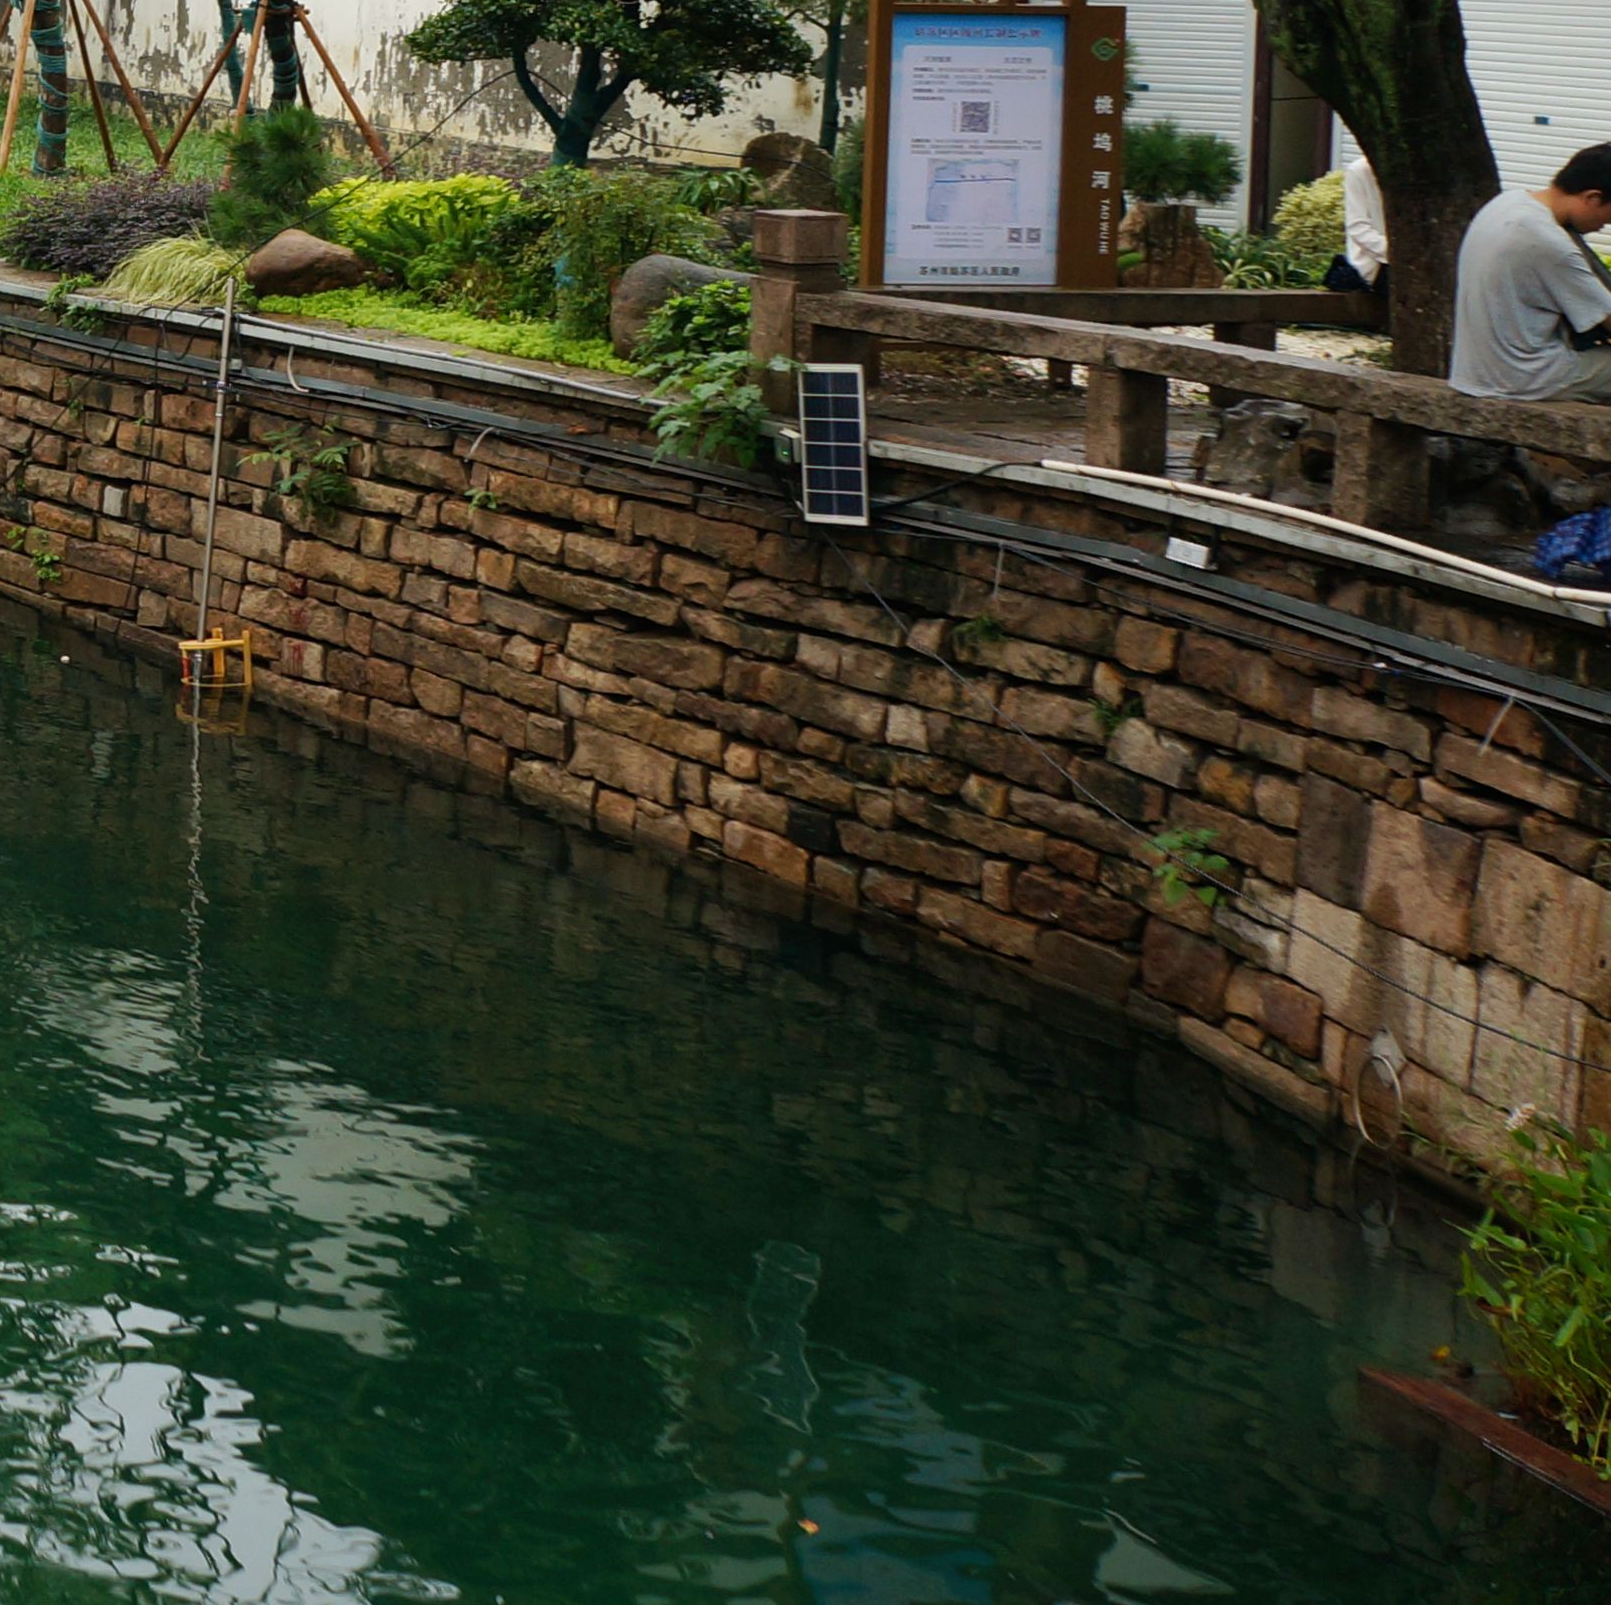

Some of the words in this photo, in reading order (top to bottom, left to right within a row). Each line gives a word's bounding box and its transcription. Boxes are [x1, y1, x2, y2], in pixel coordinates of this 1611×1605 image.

[1092, 95, 1114, 189] 桃坞河
[1099, 199, 1110, 220] TAO
[1099, 222, 1110, 239] WU
